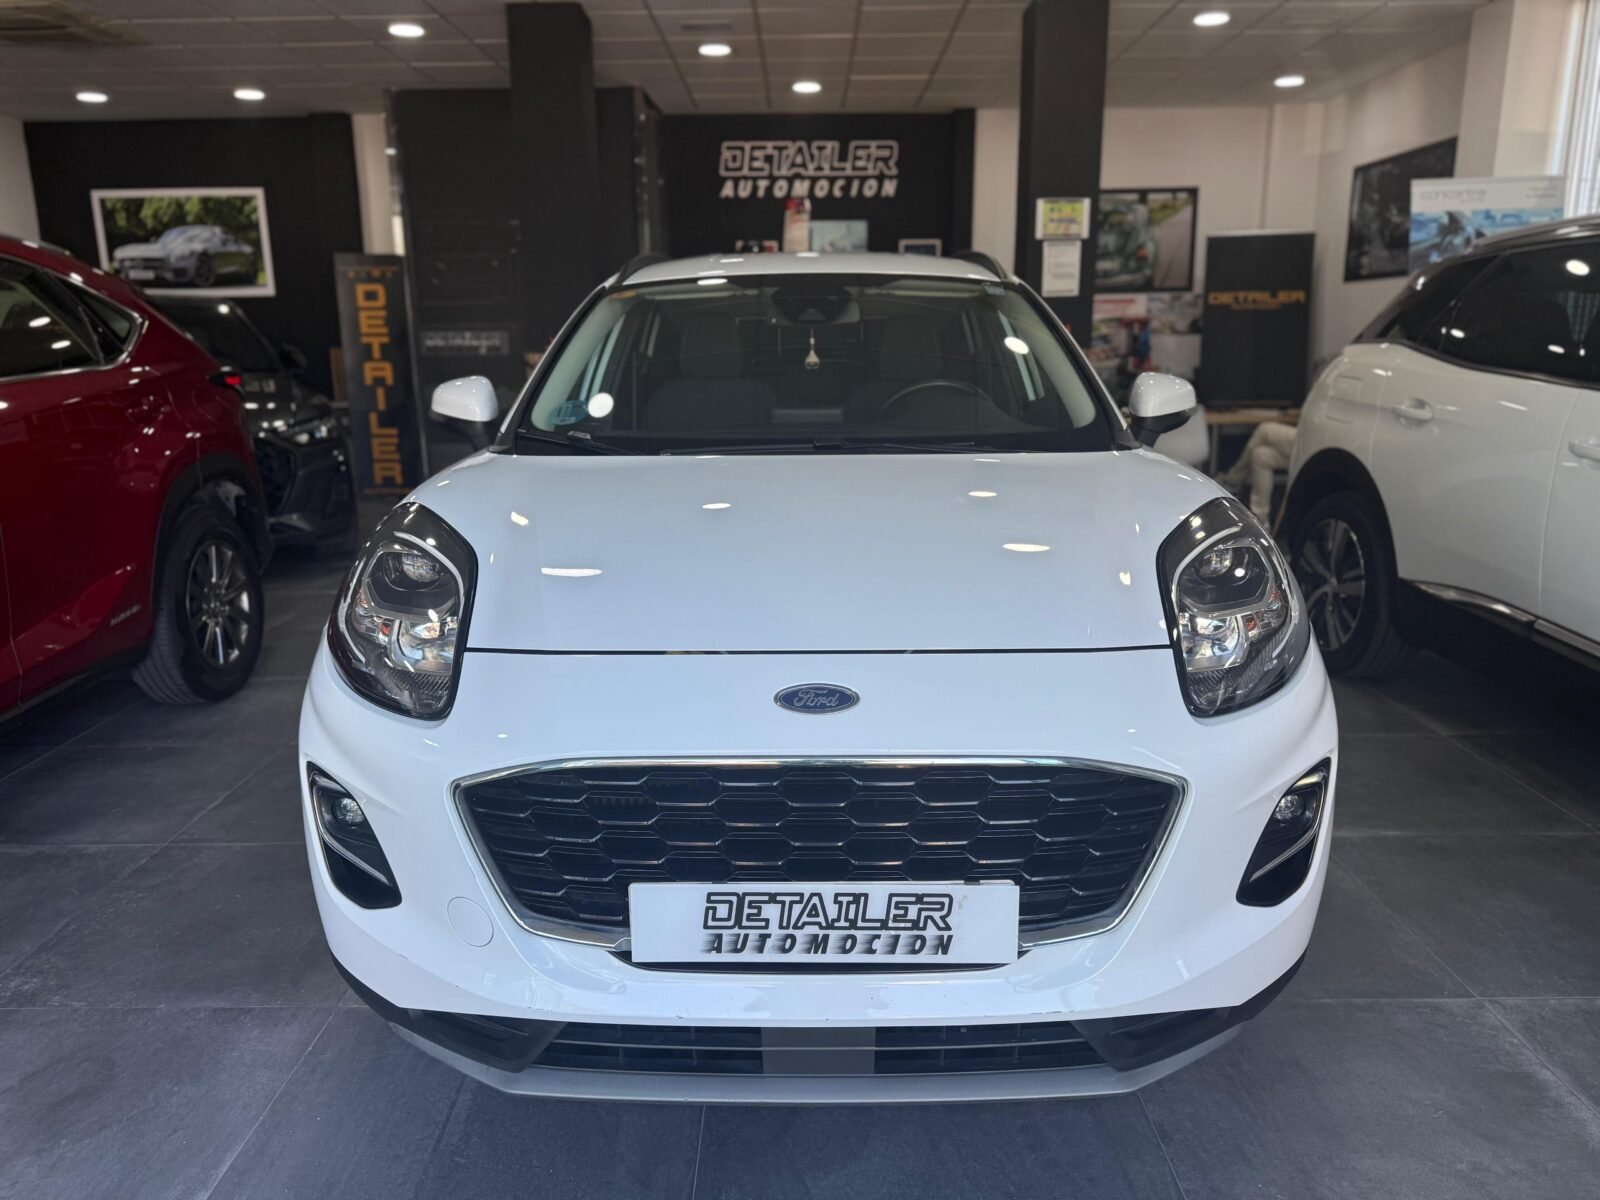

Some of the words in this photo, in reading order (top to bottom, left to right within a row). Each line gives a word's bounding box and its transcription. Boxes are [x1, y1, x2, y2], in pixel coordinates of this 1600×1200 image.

[719, 140, 899, 177] DETAILER
[719, 178, 899, 198] AUTOMOCION
[355, 283, 403, 485] DETAILER
[794, 690, 840, 706] Ford
[703, 892, 954, 932] DETAILER
[703, 933, 954, 955] AUTOMOCION
